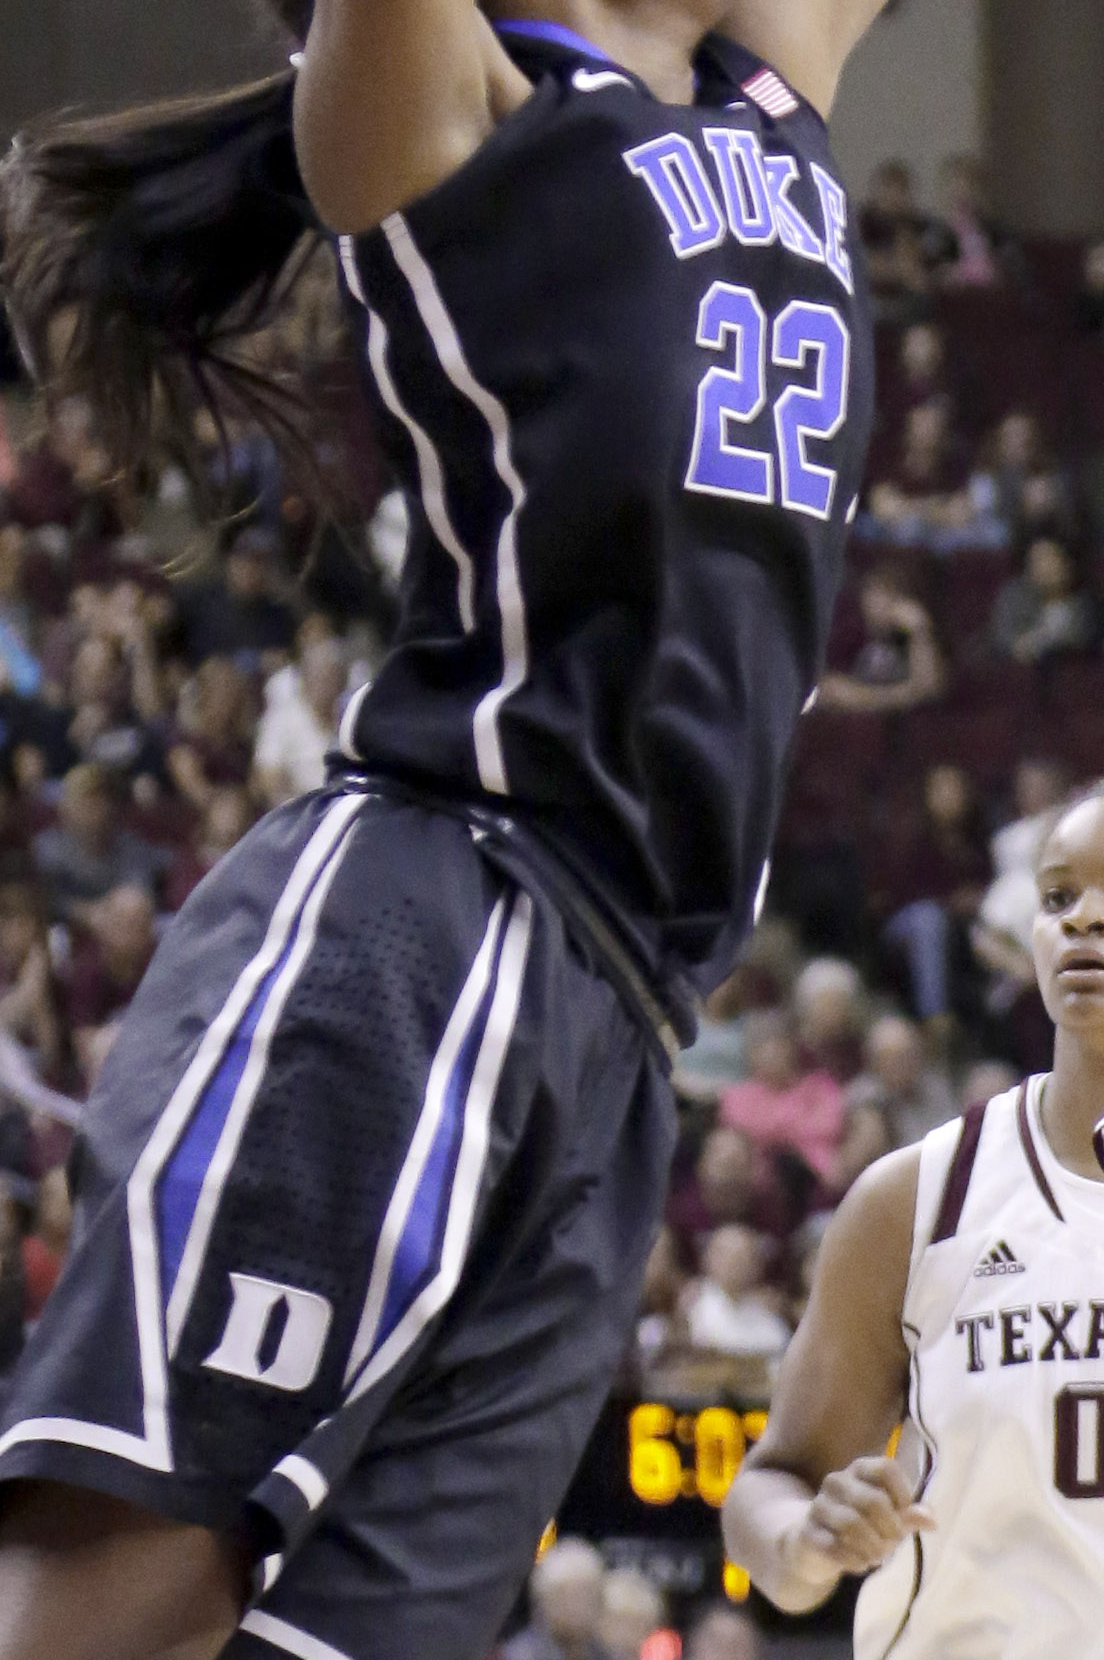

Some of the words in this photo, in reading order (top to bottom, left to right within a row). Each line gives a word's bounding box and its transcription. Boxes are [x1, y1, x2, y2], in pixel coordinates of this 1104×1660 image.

[622, 127, 854, 296] DUKE
[684, 280, 850, 521] 22
[201, 1272, 334, 1391] D
[974, 1261, 1026, 1277] adidas
